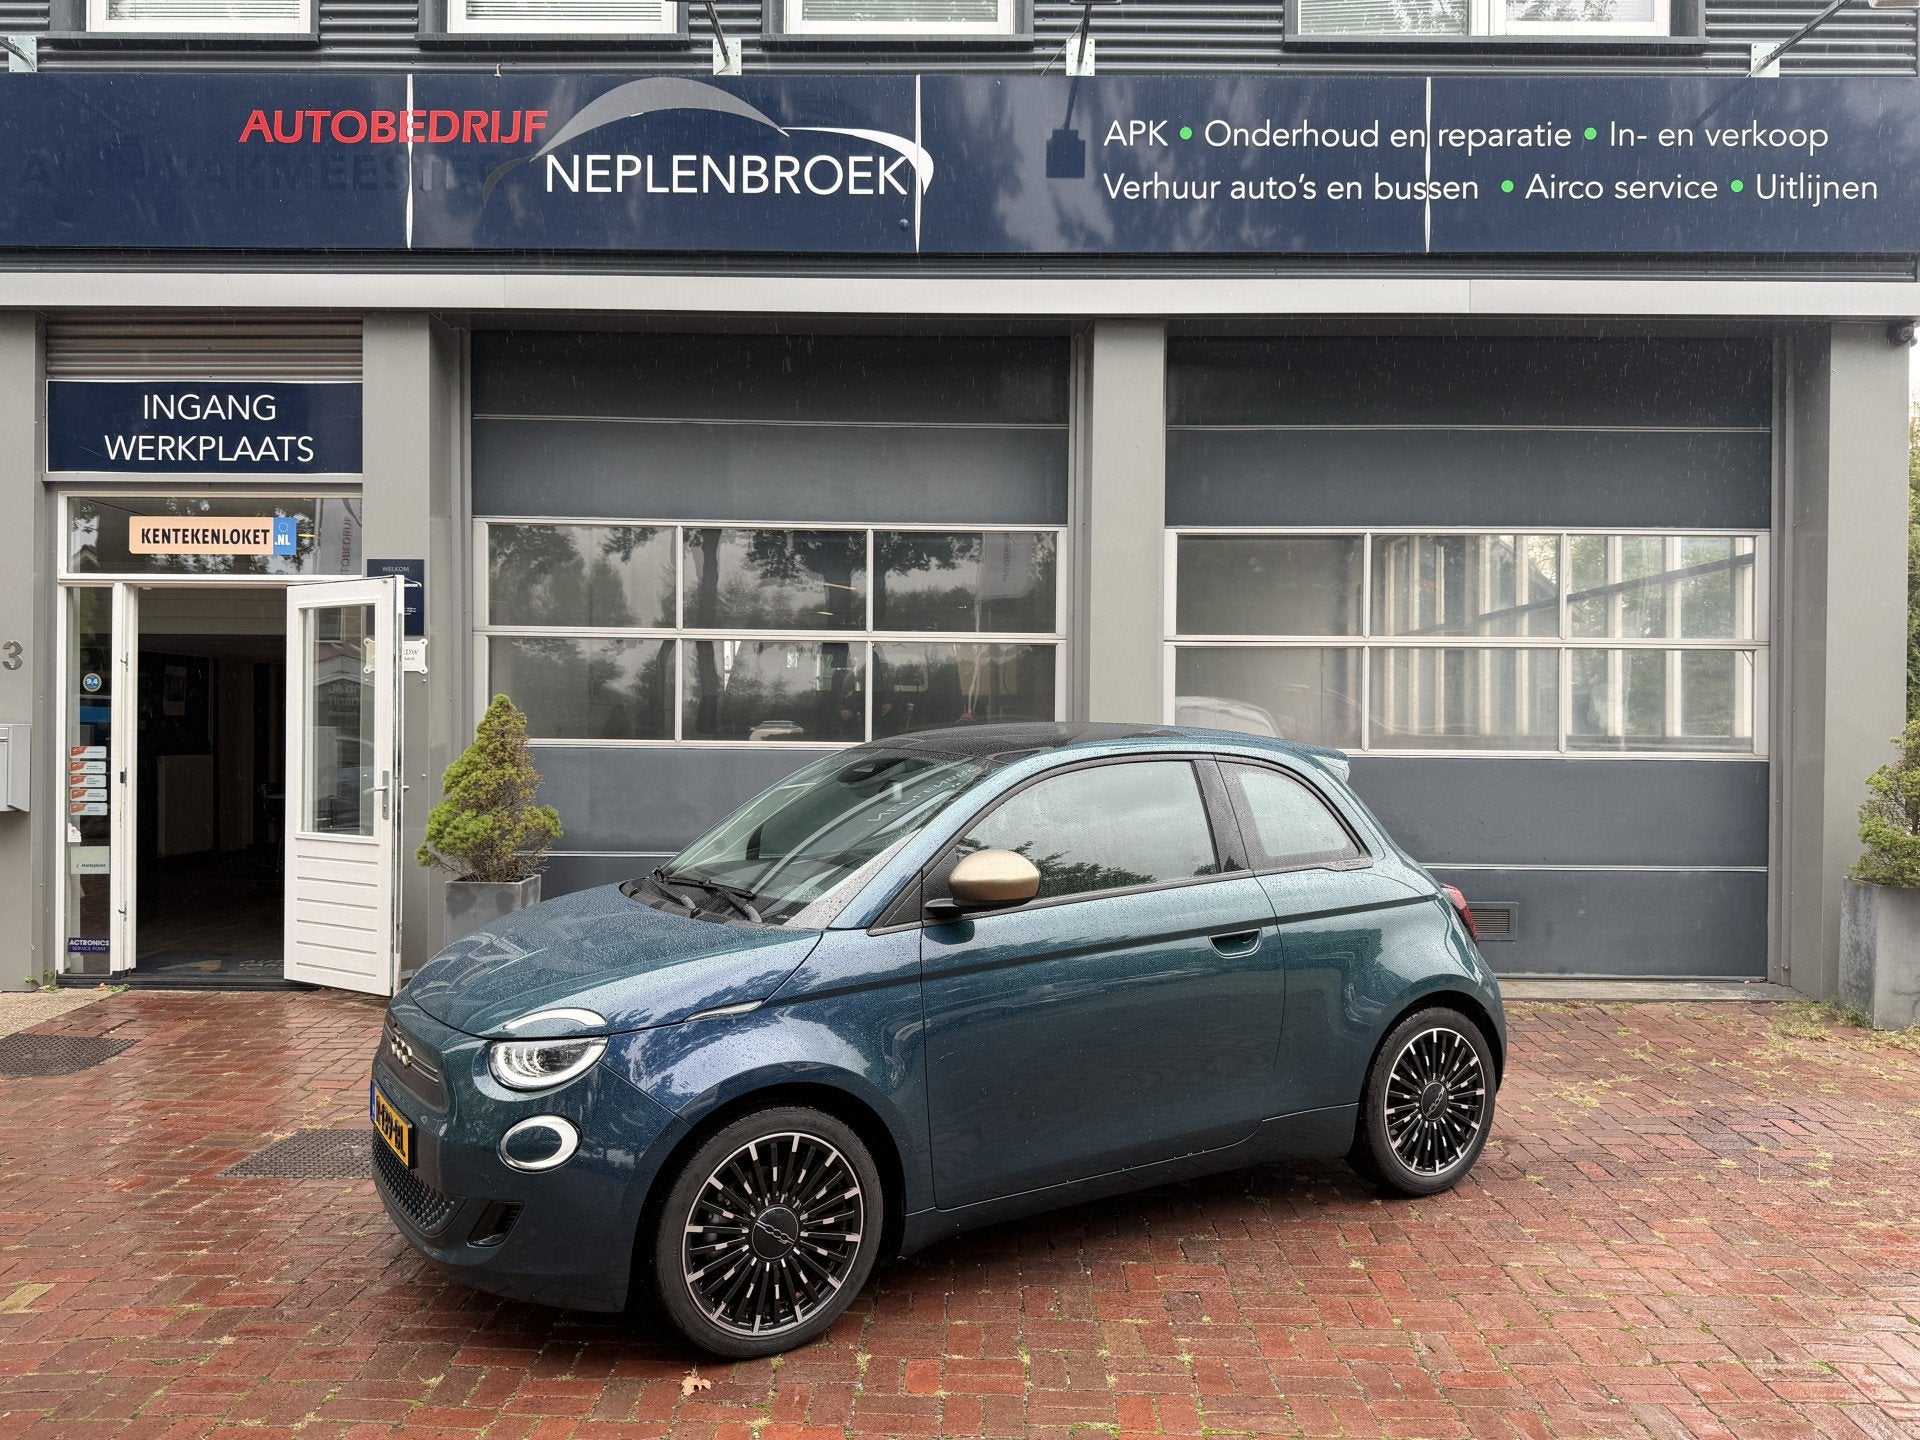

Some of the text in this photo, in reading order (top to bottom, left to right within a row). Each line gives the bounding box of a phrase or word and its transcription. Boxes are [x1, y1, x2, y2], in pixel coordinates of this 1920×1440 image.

[238, 110, 549, 144] AUTOBEDRIJF
[1103, 119, 1830, 157] APK Onderhoud en reparatie In- en verkoop
[545, 154, 908, 196] NEPLENBROEK
[1103, 172, 1221, 200] Verhuur
[1326, 180, 1362, 200] en
[1374, 172, 1479, 201] bussen
[1524, 173, 1604, 200] Airco
[1614, 174, 1718, 200] service
[1756, 172, 1878, 207] Uitlijnen
[144, 393, 276, 421] INGANG
[104, 435, 314, 462] WERKPLAATS
[141, 528, 270, 545] KENTEKENLOKET
[2, 640, 23, 670] 3
